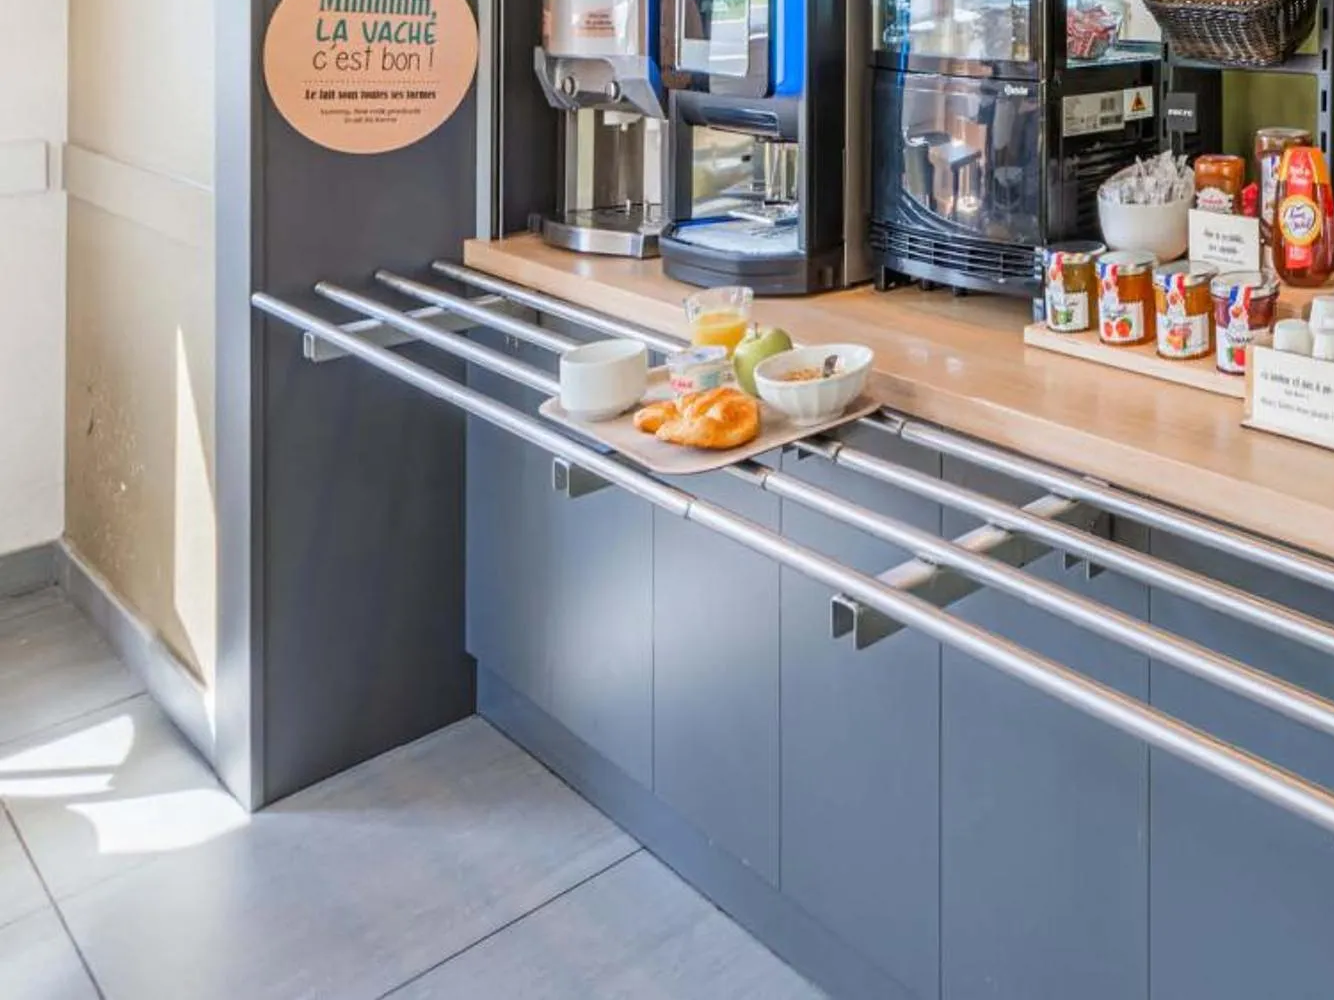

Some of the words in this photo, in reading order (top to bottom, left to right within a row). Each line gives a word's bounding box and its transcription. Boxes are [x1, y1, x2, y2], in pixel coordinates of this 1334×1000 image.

[316, 19, 349, 42] LA
[362, 20, 438, 45] VACHE
[312, 43, 372, 71] c'est
[381, 47, 421, 71] bon
